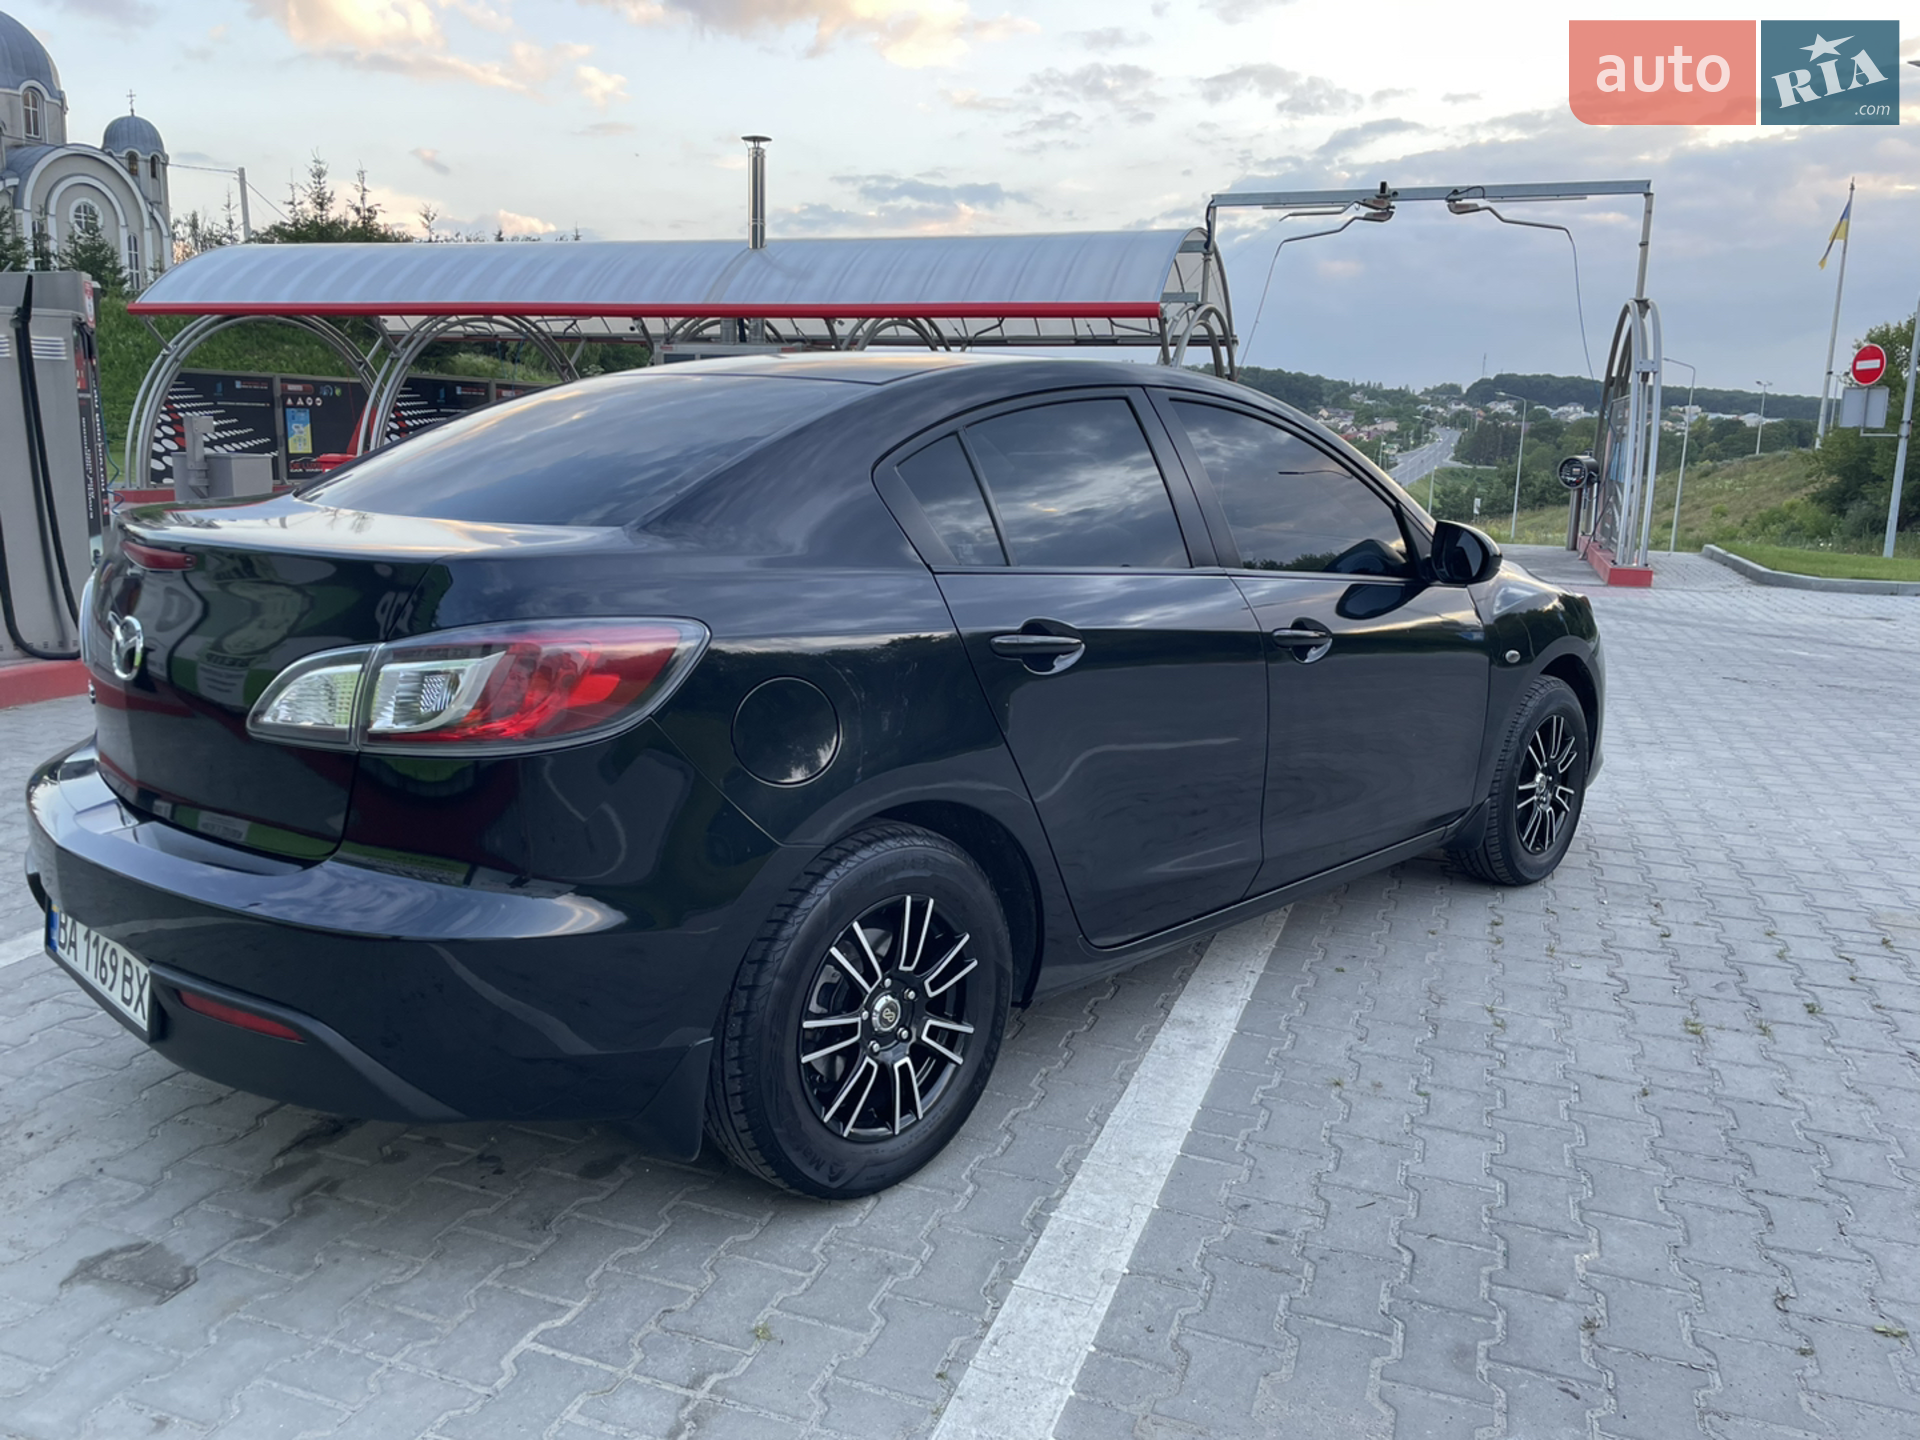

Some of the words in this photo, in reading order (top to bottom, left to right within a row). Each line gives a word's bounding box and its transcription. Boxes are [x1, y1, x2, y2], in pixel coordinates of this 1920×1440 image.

[58, 910, 78, 962] BA
[83, 928, 118, 992] 1169
[121, 956, 149, 1020] BX
